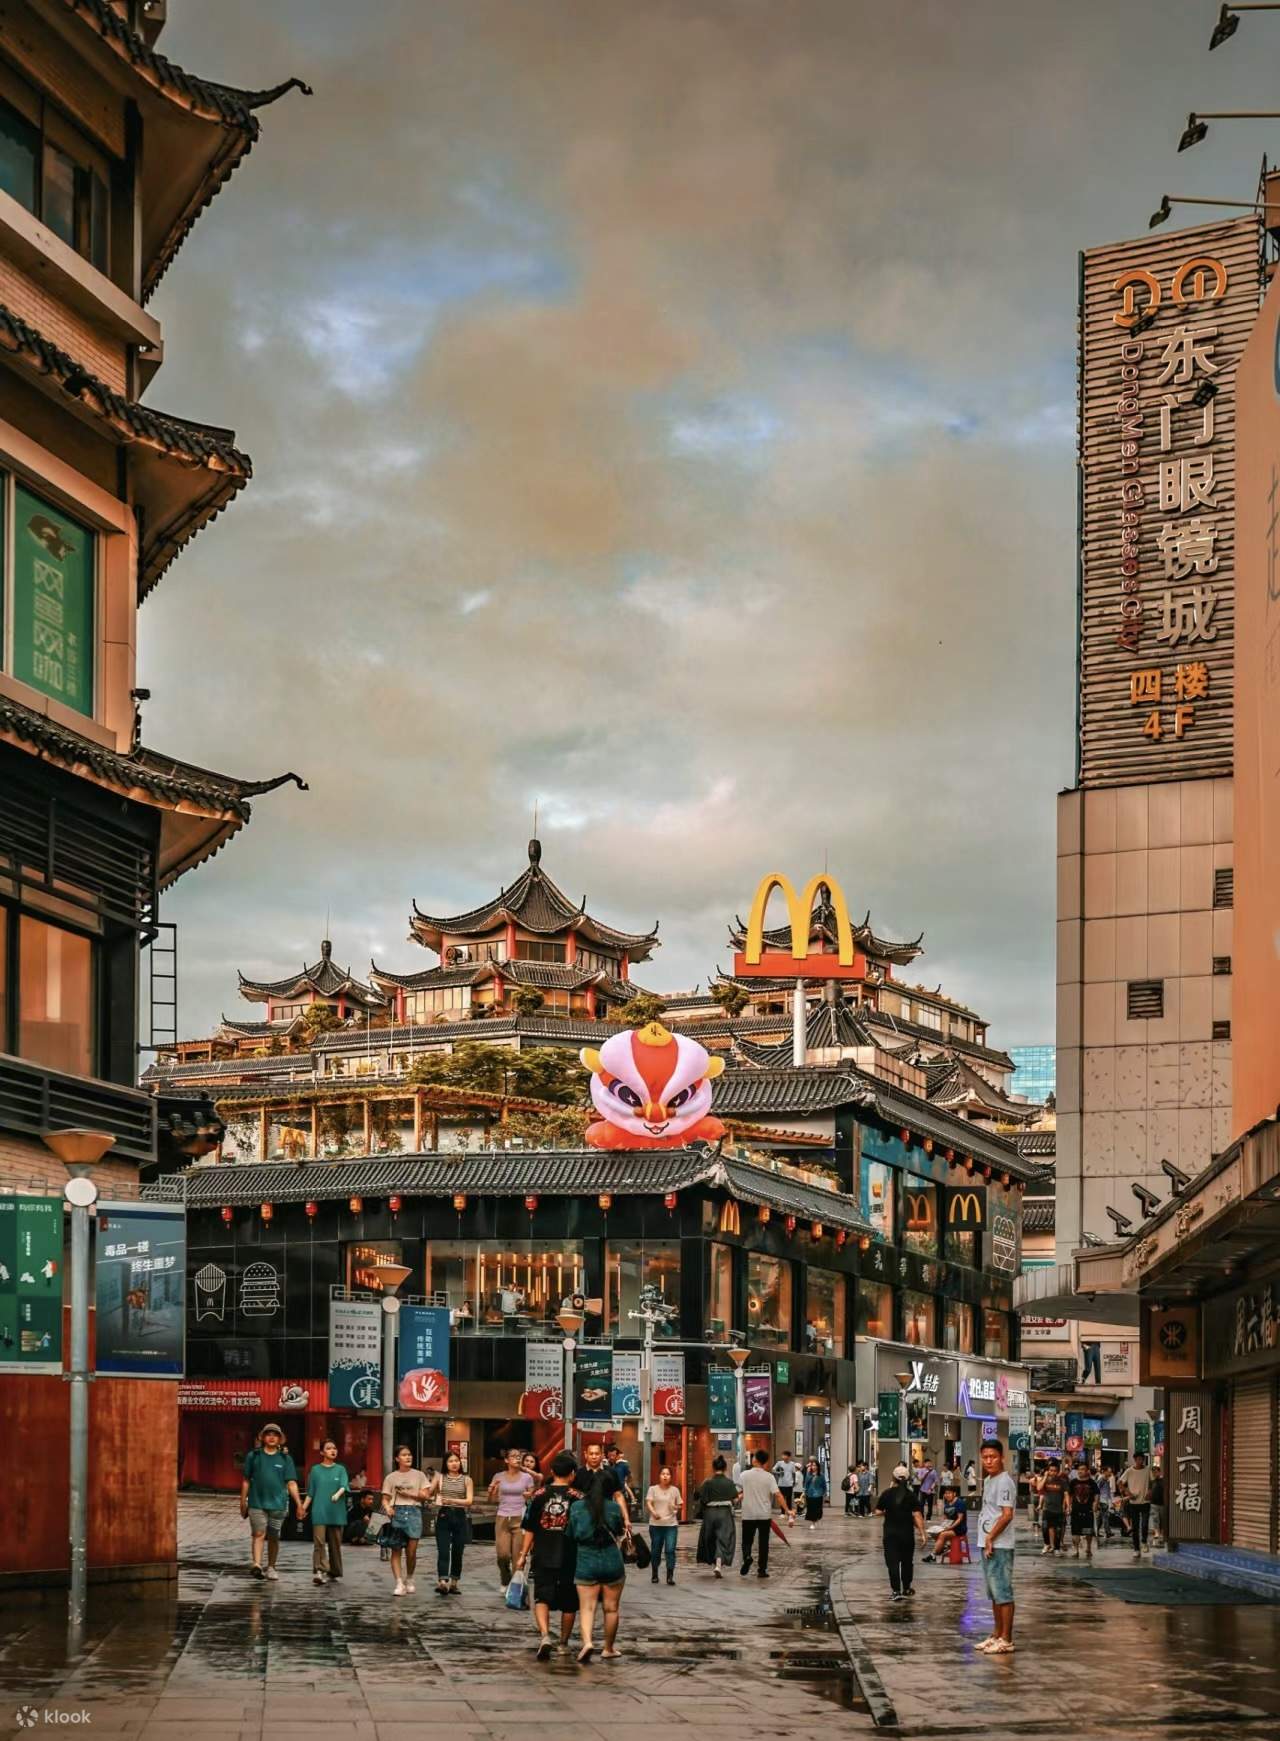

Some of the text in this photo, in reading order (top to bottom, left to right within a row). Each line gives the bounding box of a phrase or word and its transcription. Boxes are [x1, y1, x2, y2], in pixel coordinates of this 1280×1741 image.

[1118, 342, 1144, 474] DongMen
[1121, 479, 1145, 592] Glasses
[1157, 326, 1219, 646] 东门眼镜城
[1130, 661, 1210, 705] 四楼
[1143, 704, 1195, 741] 4F
[104, 1240, 150, 1257] 毒品一碰
[1175, 1406, 1202, 1512] 周六福
